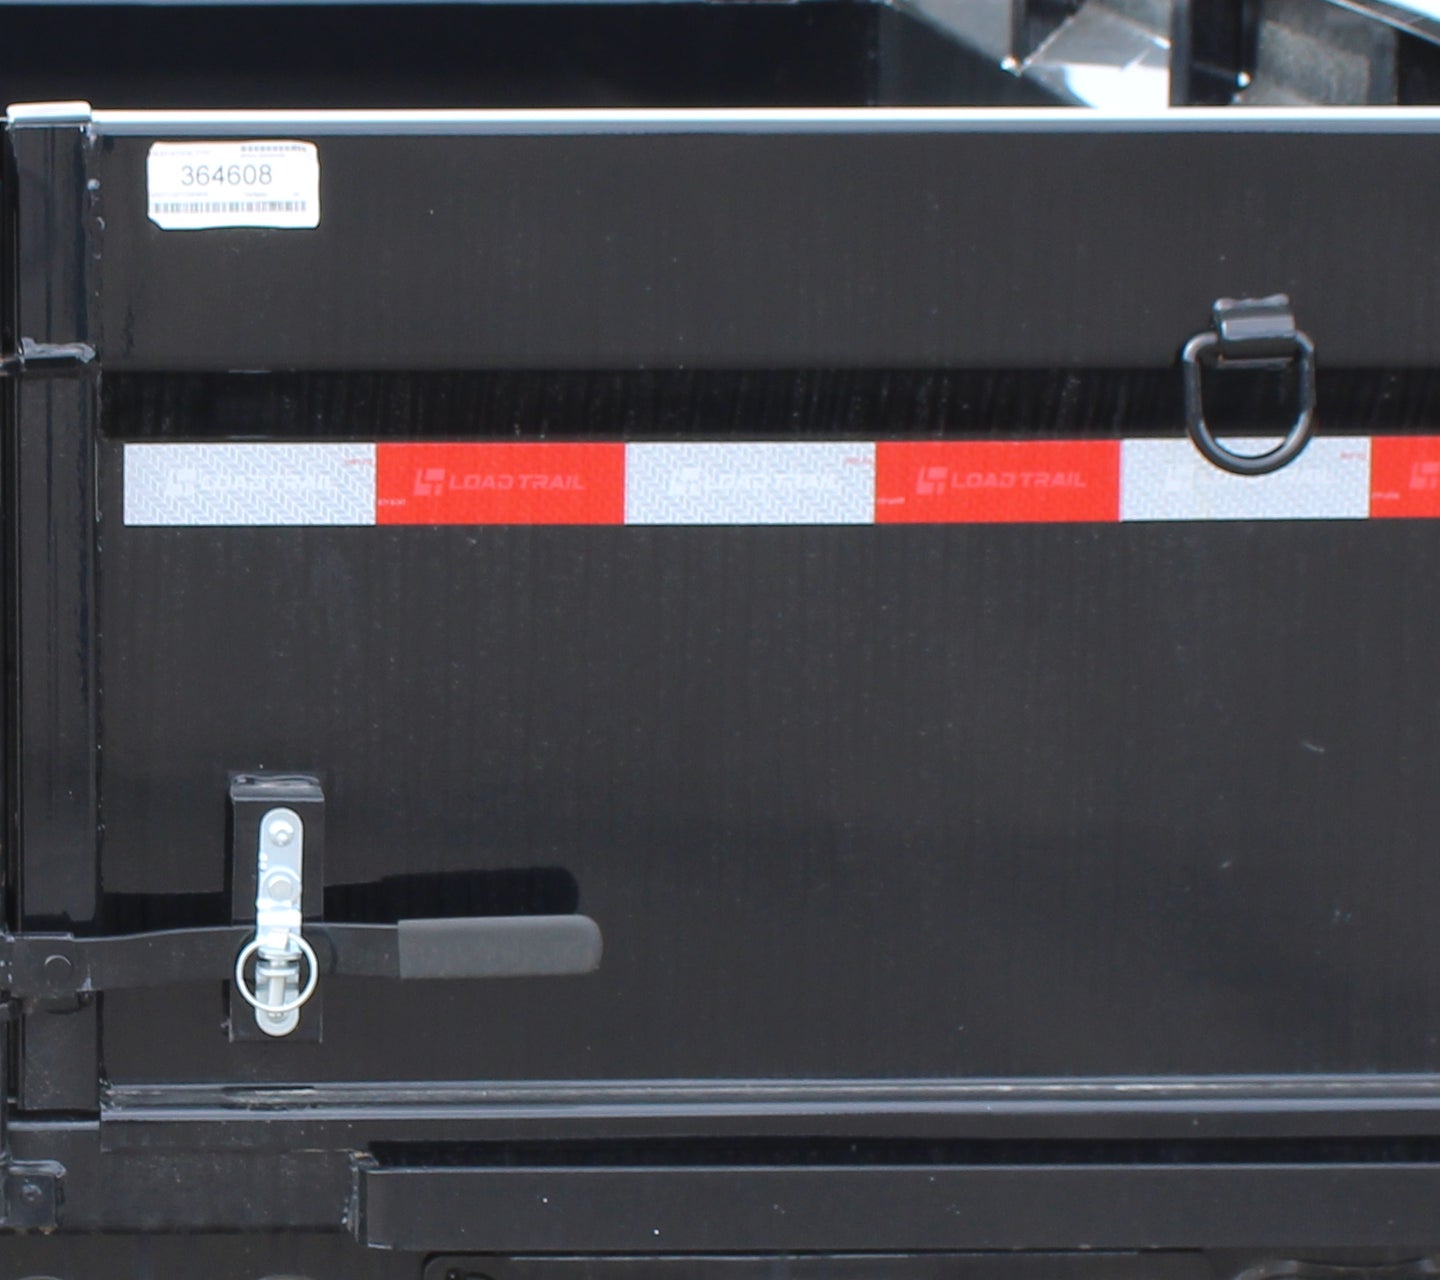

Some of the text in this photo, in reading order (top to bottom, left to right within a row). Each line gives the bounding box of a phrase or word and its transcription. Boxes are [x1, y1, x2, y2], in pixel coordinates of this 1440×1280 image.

[180, 164, 273, 186] 364608
[448, 473, 585, 490] LOAD TRAIL
[951, 471, 1087, 488] LOAD TRAIL
